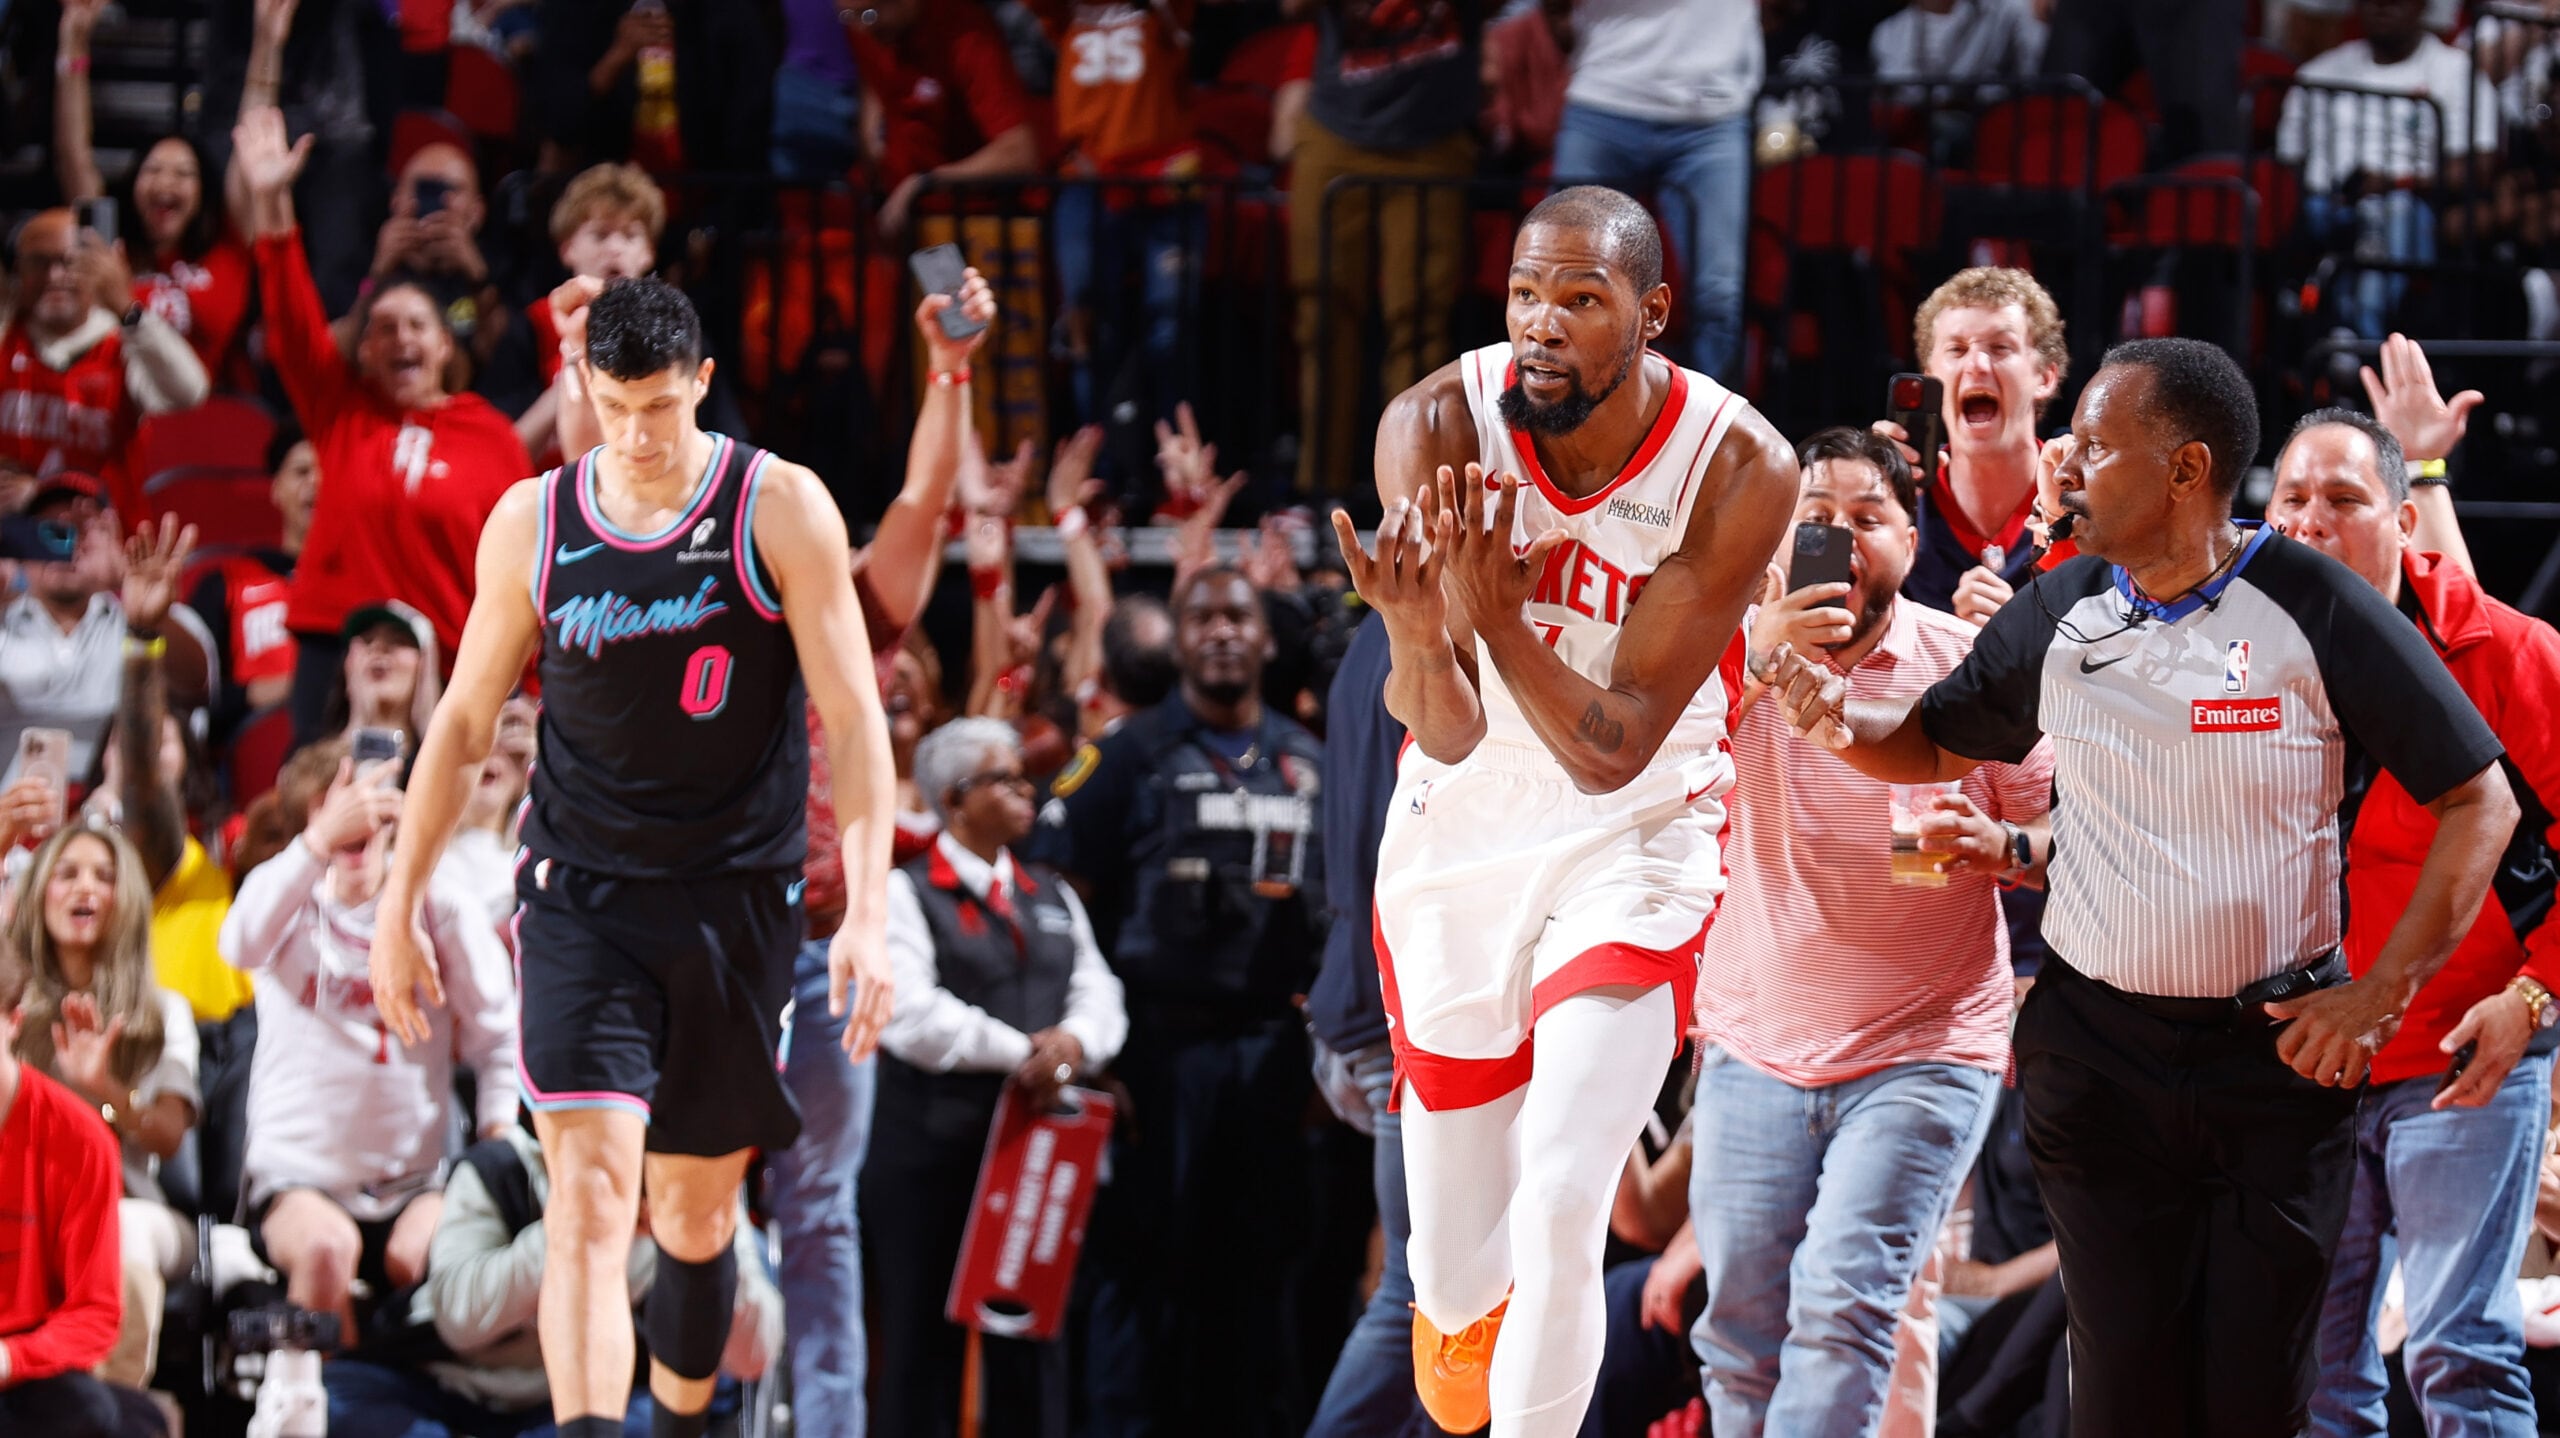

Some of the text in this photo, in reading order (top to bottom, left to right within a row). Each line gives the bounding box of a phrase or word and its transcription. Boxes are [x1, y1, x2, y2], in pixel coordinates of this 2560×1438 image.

[1070, 27, 1145, 86] 35
[1607, 504, 1671, 528] HERMANN
[1609, 497, 1671, 519] MEMORIAL
[549, 575, 730, 661] Miami
[678, 645, 735, 722] 0
[2193, 705, 2280, 725] Emirates
